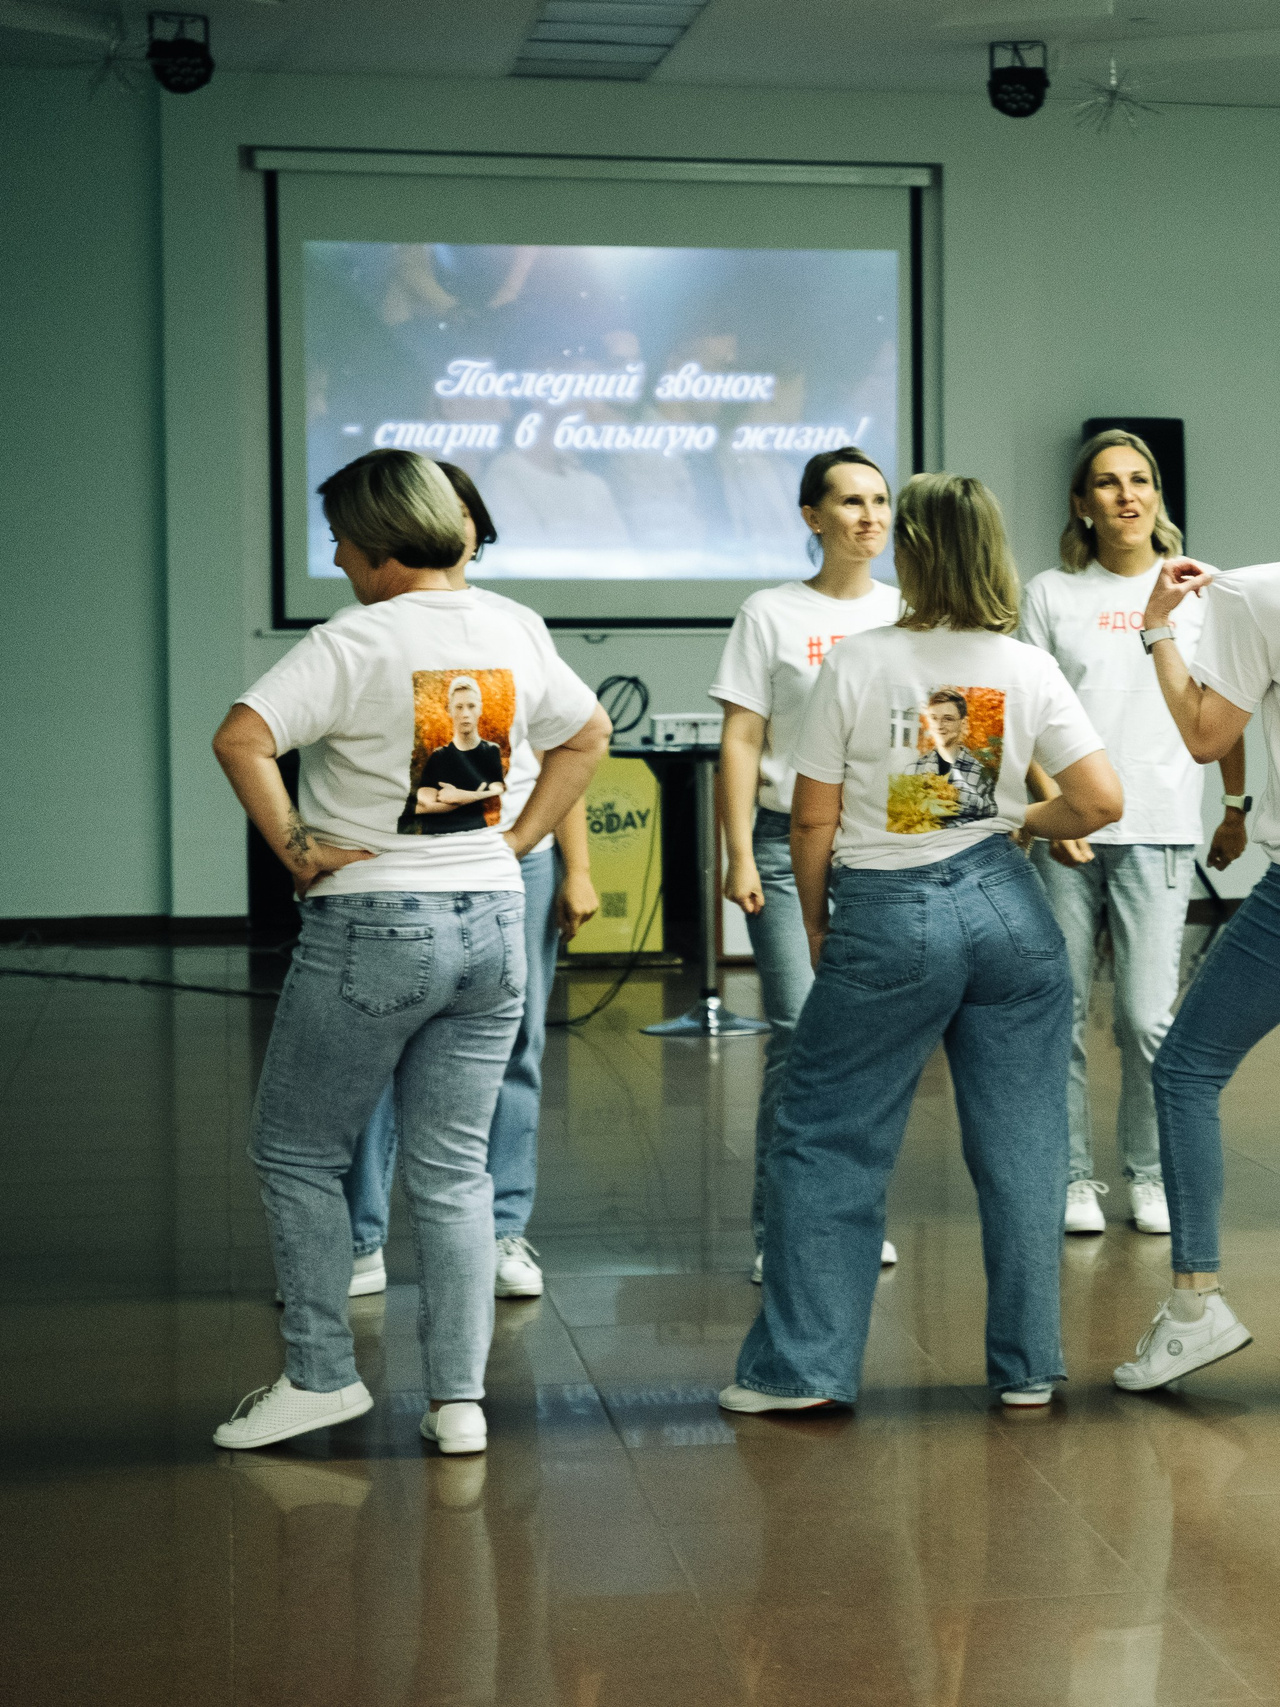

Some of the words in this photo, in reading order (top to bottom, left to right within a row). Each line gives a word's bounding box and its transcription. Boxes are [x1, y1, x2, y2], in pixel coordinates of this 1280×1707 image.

[434, 358, 643, 405] Последний
[655, 362, 775, 400] звонок
[373, 421, 500, 456] старт
[514, 412, 542, 449] в
[553, 413, 718, 457] большую
[731, 416, 870, 450] жизнь!
[586, 808, 650, 834] ODAY
